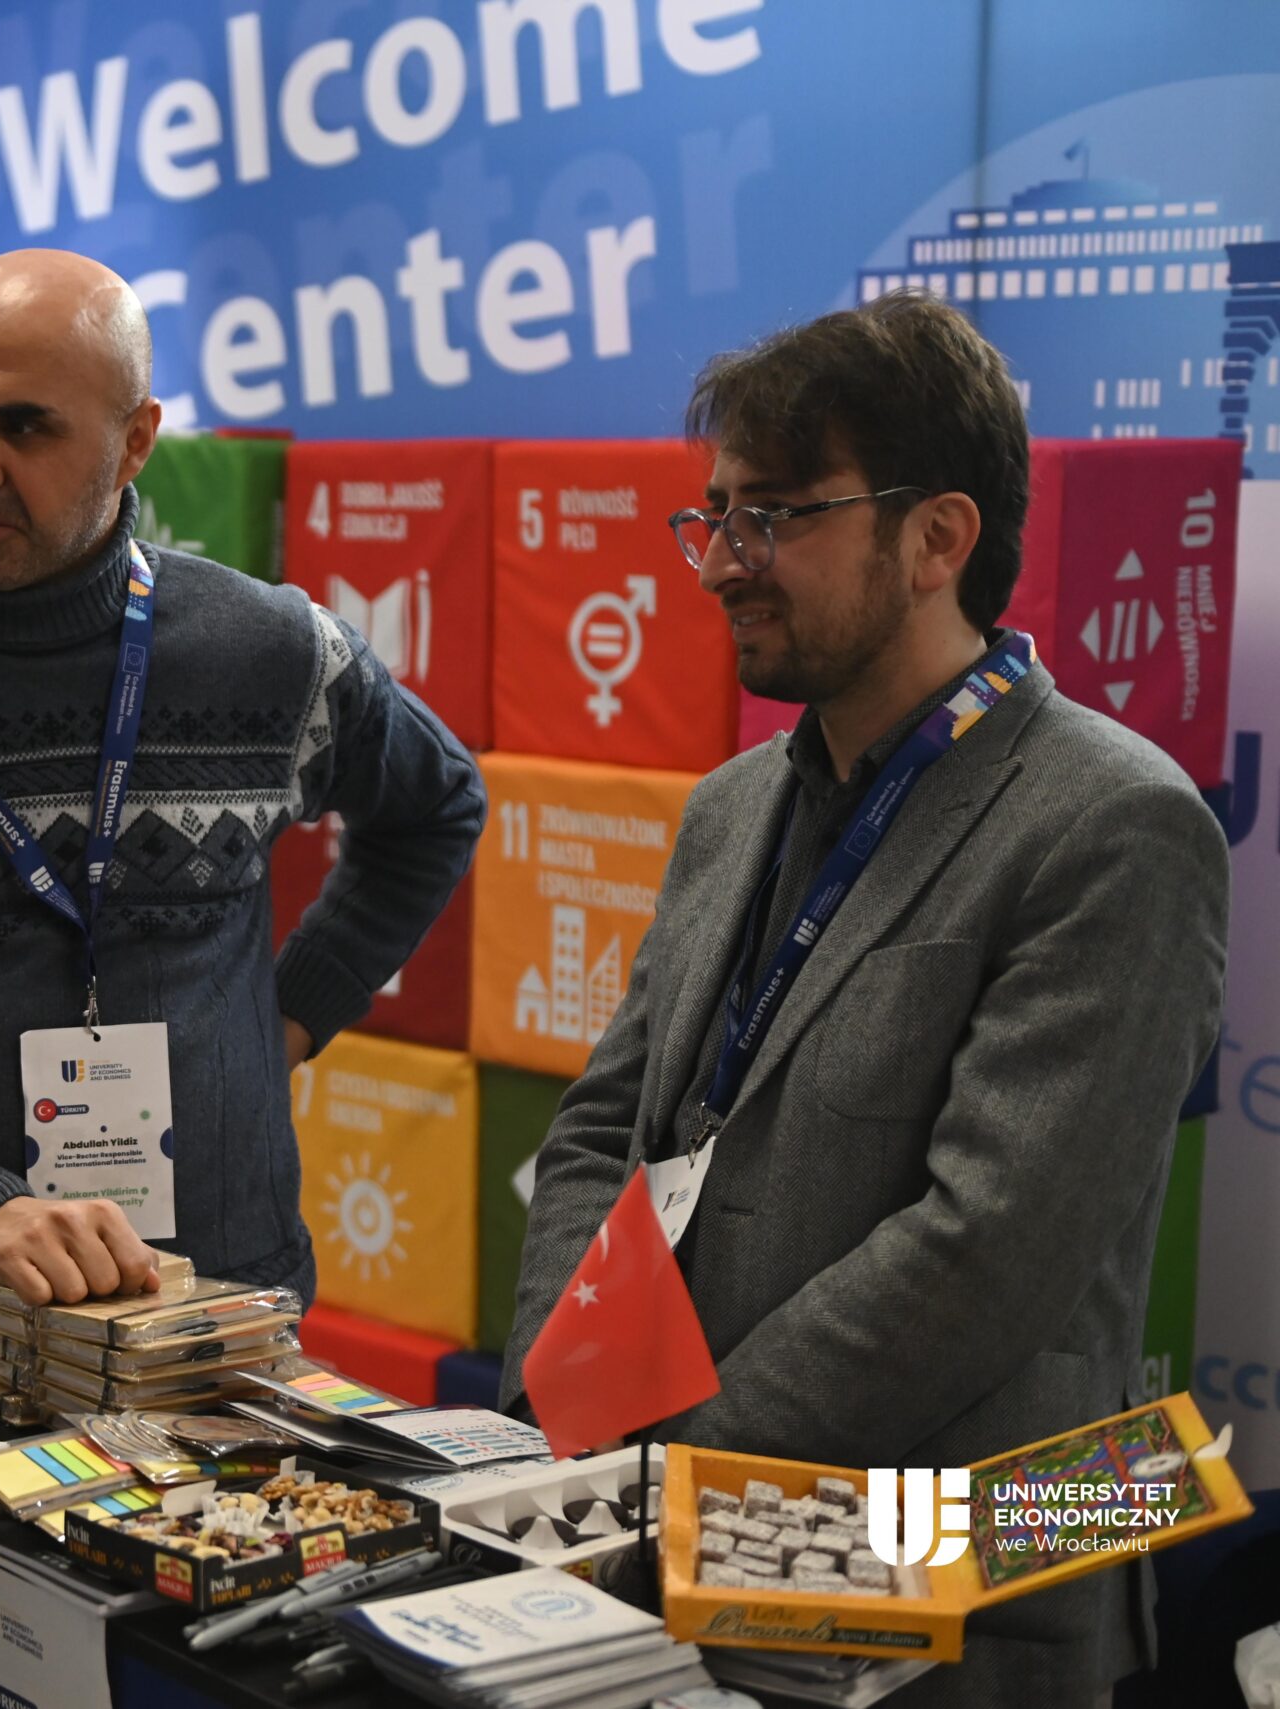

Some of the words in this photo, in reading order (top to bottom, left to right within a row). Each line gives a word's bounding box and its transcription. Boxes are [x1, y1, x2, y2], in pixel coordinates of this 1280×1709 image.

[306, 481, 331, 539] 4
[519, 489, 544, 550] 5
[1180, 488, 1216, 548] 10
[1196, 564, 1217, 633] MNIEJ
[103, 760, 128, 838] Erasmus+
[499, 800, 529, 862] 11
[738, 967, 785, 1050] Erasmus+
[57, 1152, 99, 1161] Vice-Rector
[100, 1149, 143, 1159] Responsible
[62, 1139, 109, 1150] Abdullah
[110, 1136, 138, 1147] Yildiz
[65, 1159, 113, 1168] International
[113, 1157, 147, 1165] Relations
[61, 1188, 99, 1200] Ankara
[100, 1187, 139, 1198] Yildirim
